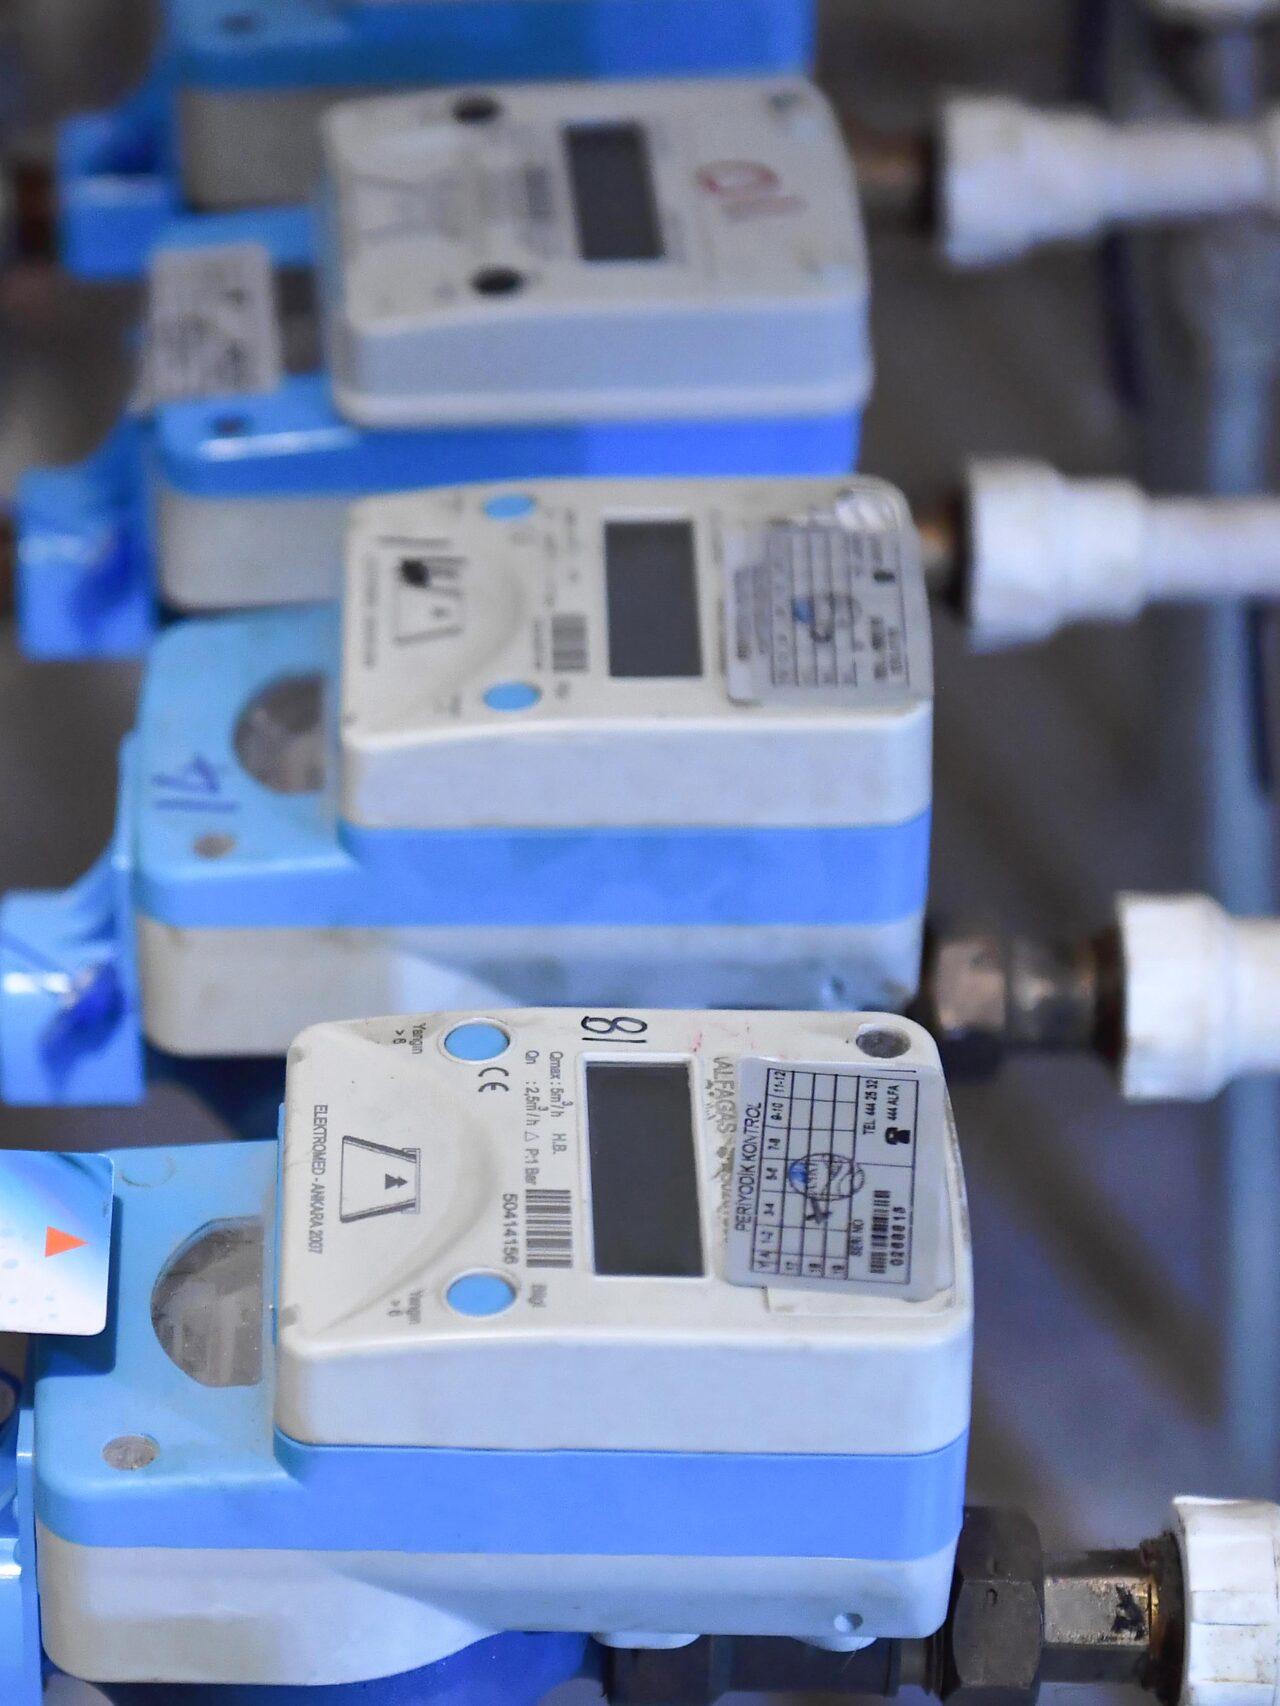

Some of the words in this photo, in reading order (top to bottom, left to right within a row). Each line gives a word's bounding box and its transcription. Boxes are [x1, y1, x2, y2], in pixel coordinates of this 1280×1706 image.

[478, 1067, 509, 1092] CE
[773, 1071, 786, 1091] 11-12
[887, 1085, 899, 1106] ALFA
[312, 1104, 328, 1176] ELEKTROMED
[742, 1102, 761, 1161] KONTROL
[310, 1183, 326, 1228] ANKARA
[502, 1193, 518, 1265] 50414156
